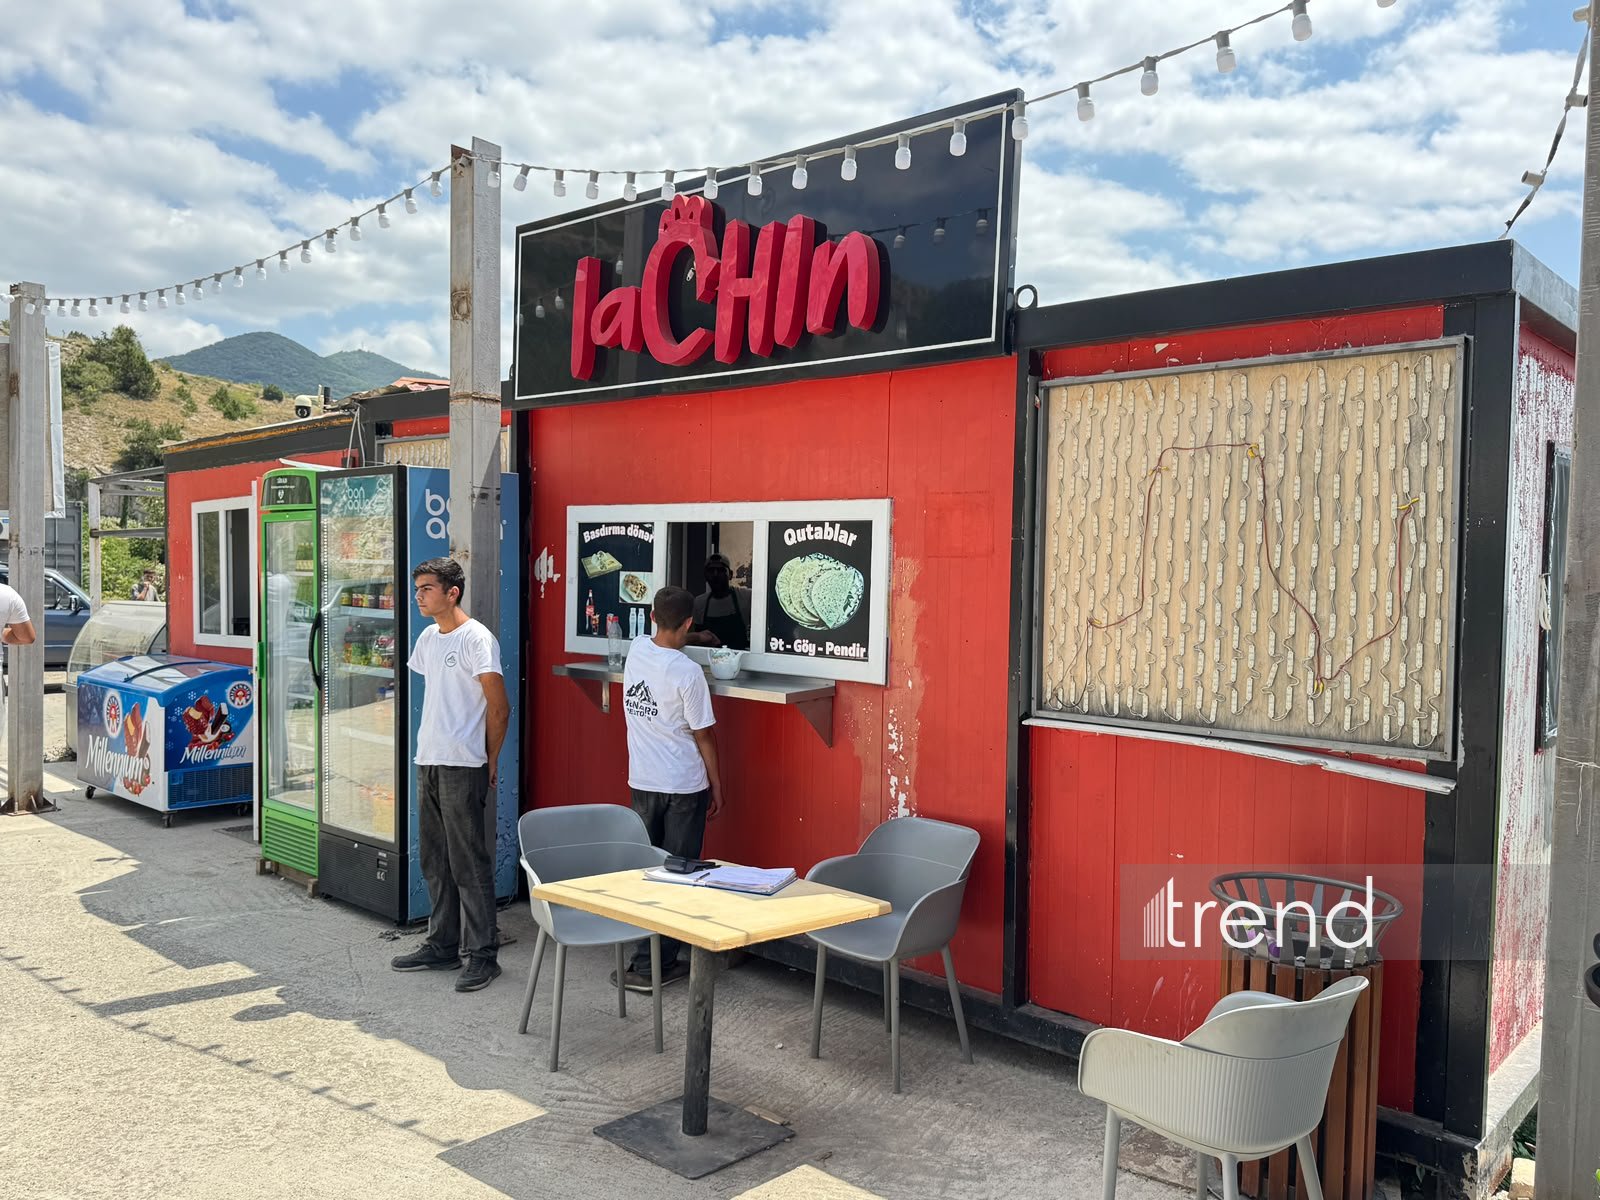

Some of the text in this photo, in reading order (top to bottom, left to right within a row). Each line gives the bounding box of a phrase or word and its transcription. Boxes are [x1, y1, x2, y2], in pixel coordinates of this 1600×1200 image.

[783, 521, 858, 547] Qutablar
[769, 637, 785, 651] Ət
[793, 639, 816, 657] Göy
[825, 641, 867, 658] Pendir
[85, 733, 145, 783] Millennium
[179, 744, 247, 764] Millennium
